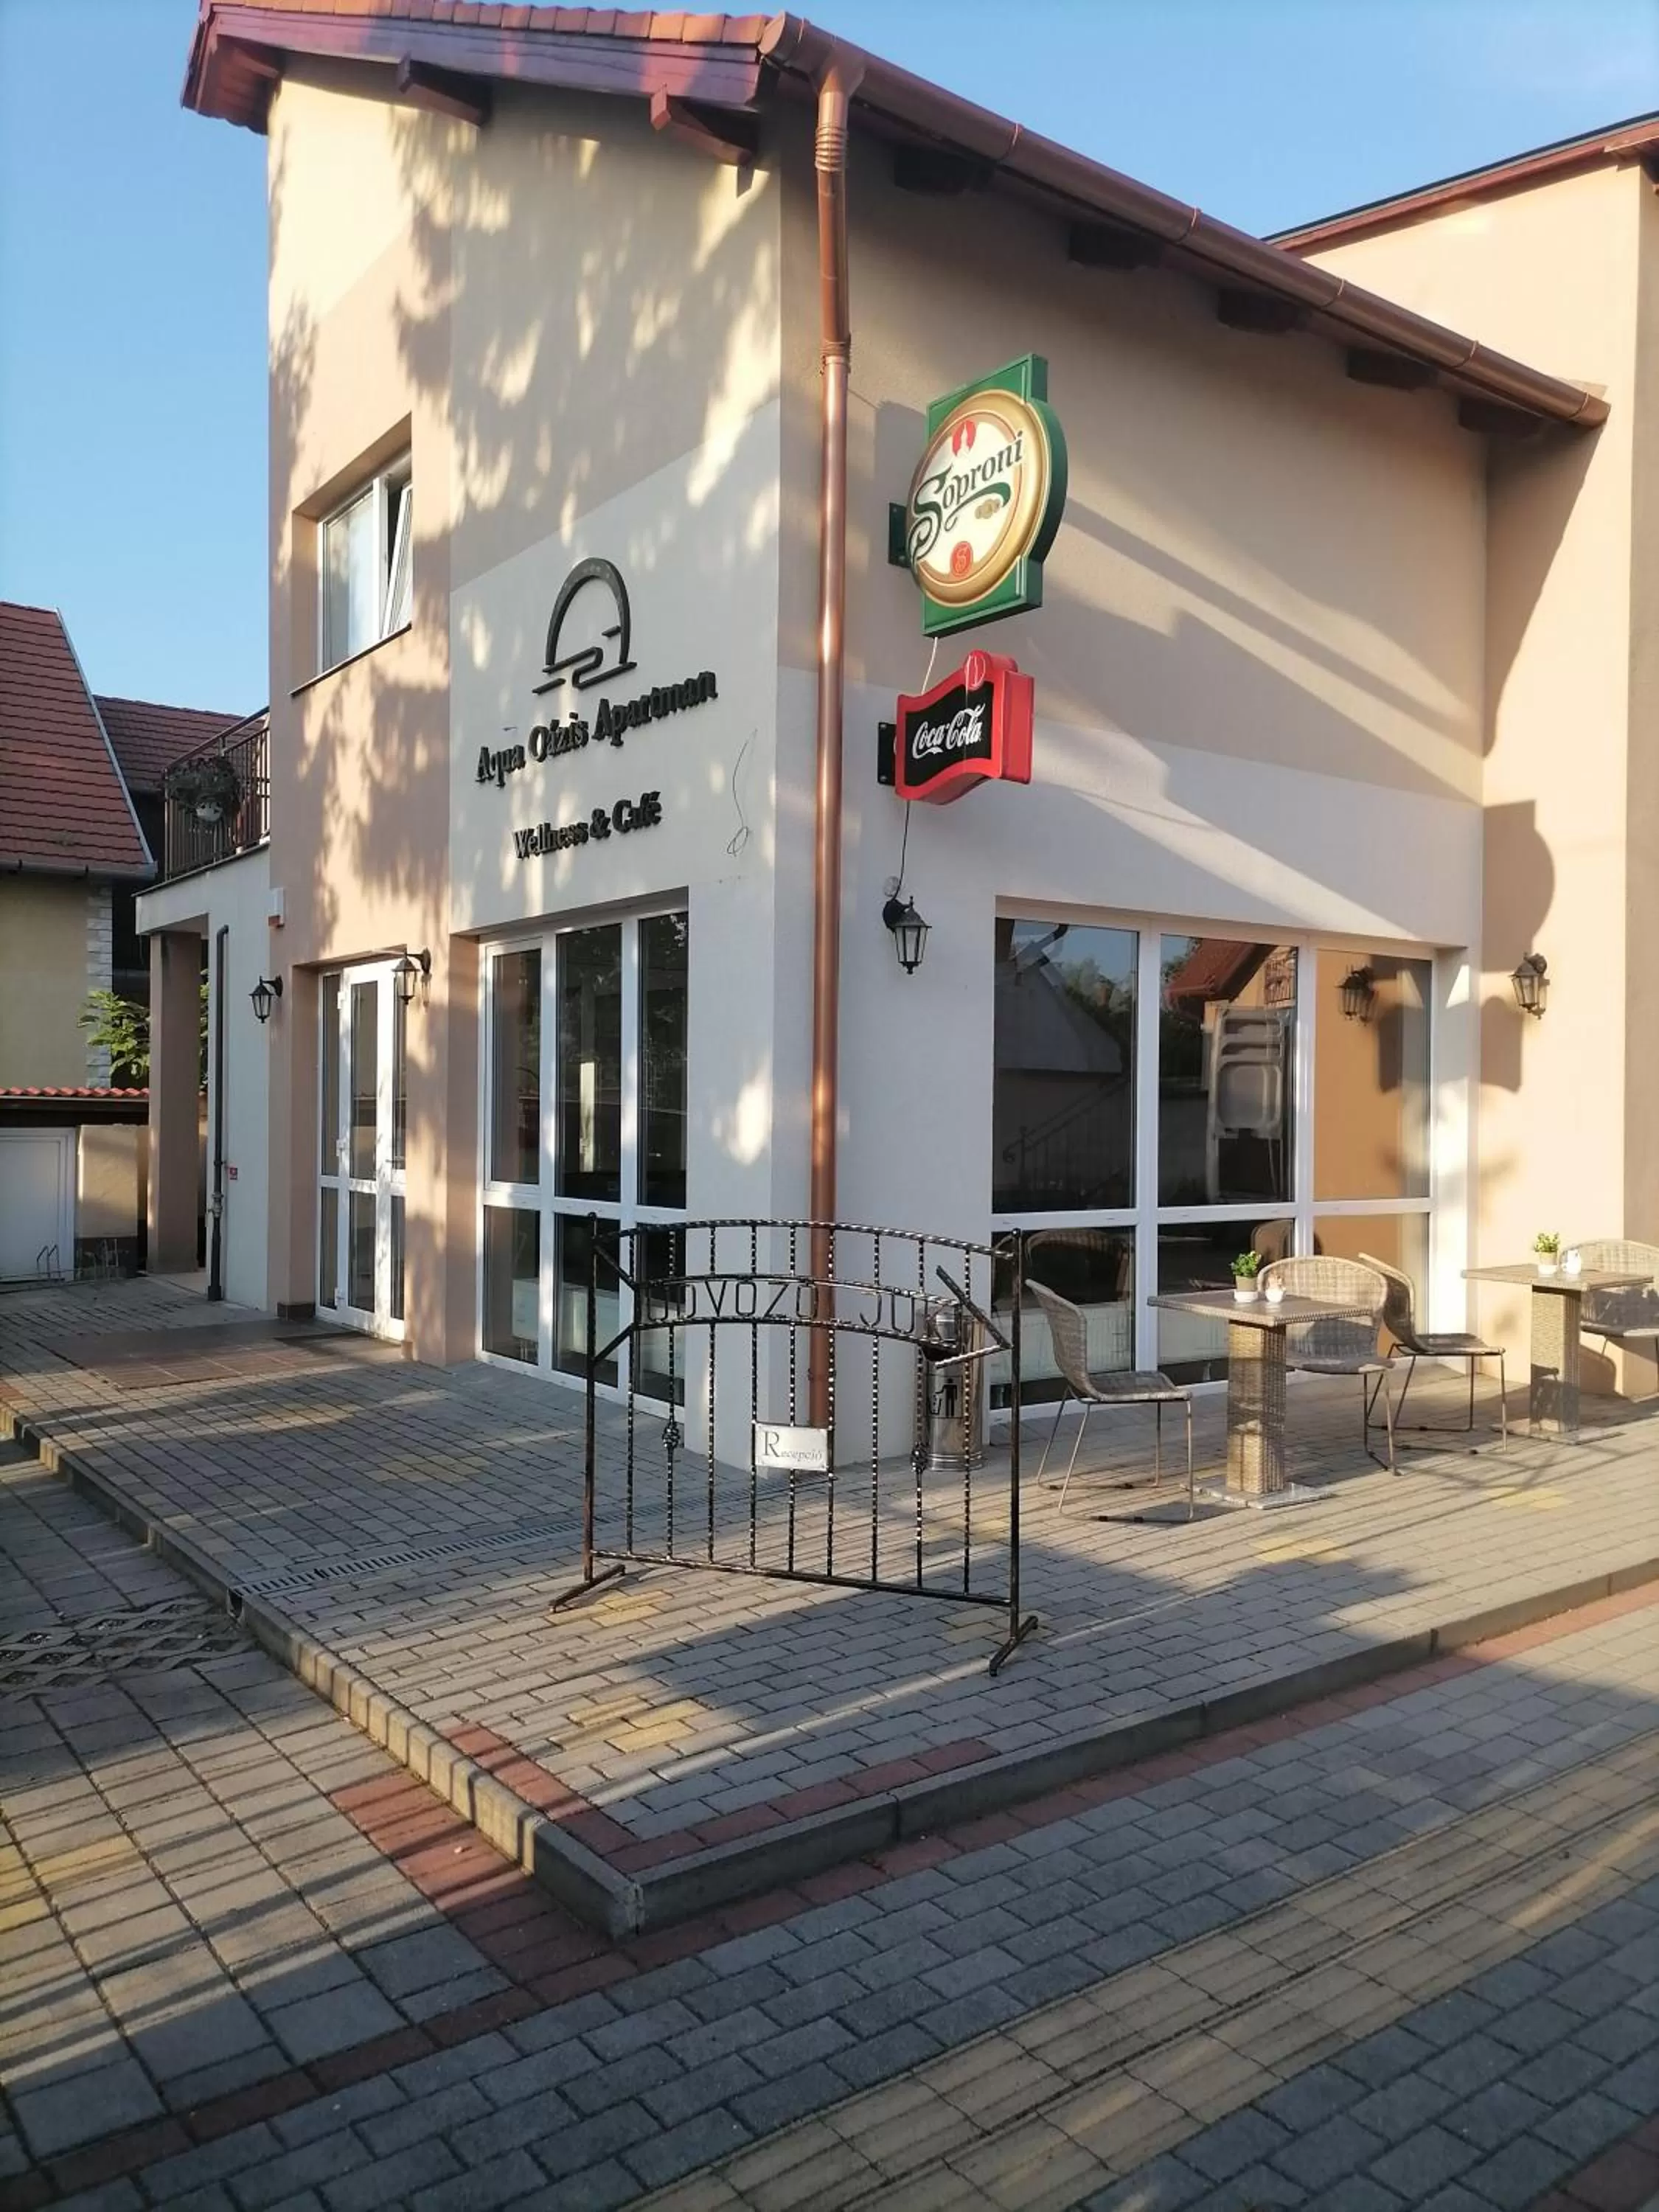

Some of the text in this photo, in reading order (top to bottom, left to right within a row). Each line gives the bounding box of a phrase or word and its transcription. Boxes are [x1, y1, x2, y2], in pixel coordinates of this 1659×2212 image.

[909, 430, 1023, 562] Soproni
[476, 745, 526, 788] Aqua
[591, 671, 719, 747] Apartman
[912, 703, 986, 759] Coca-Cola
[513, 791, 662, 860] Wellness & Café
